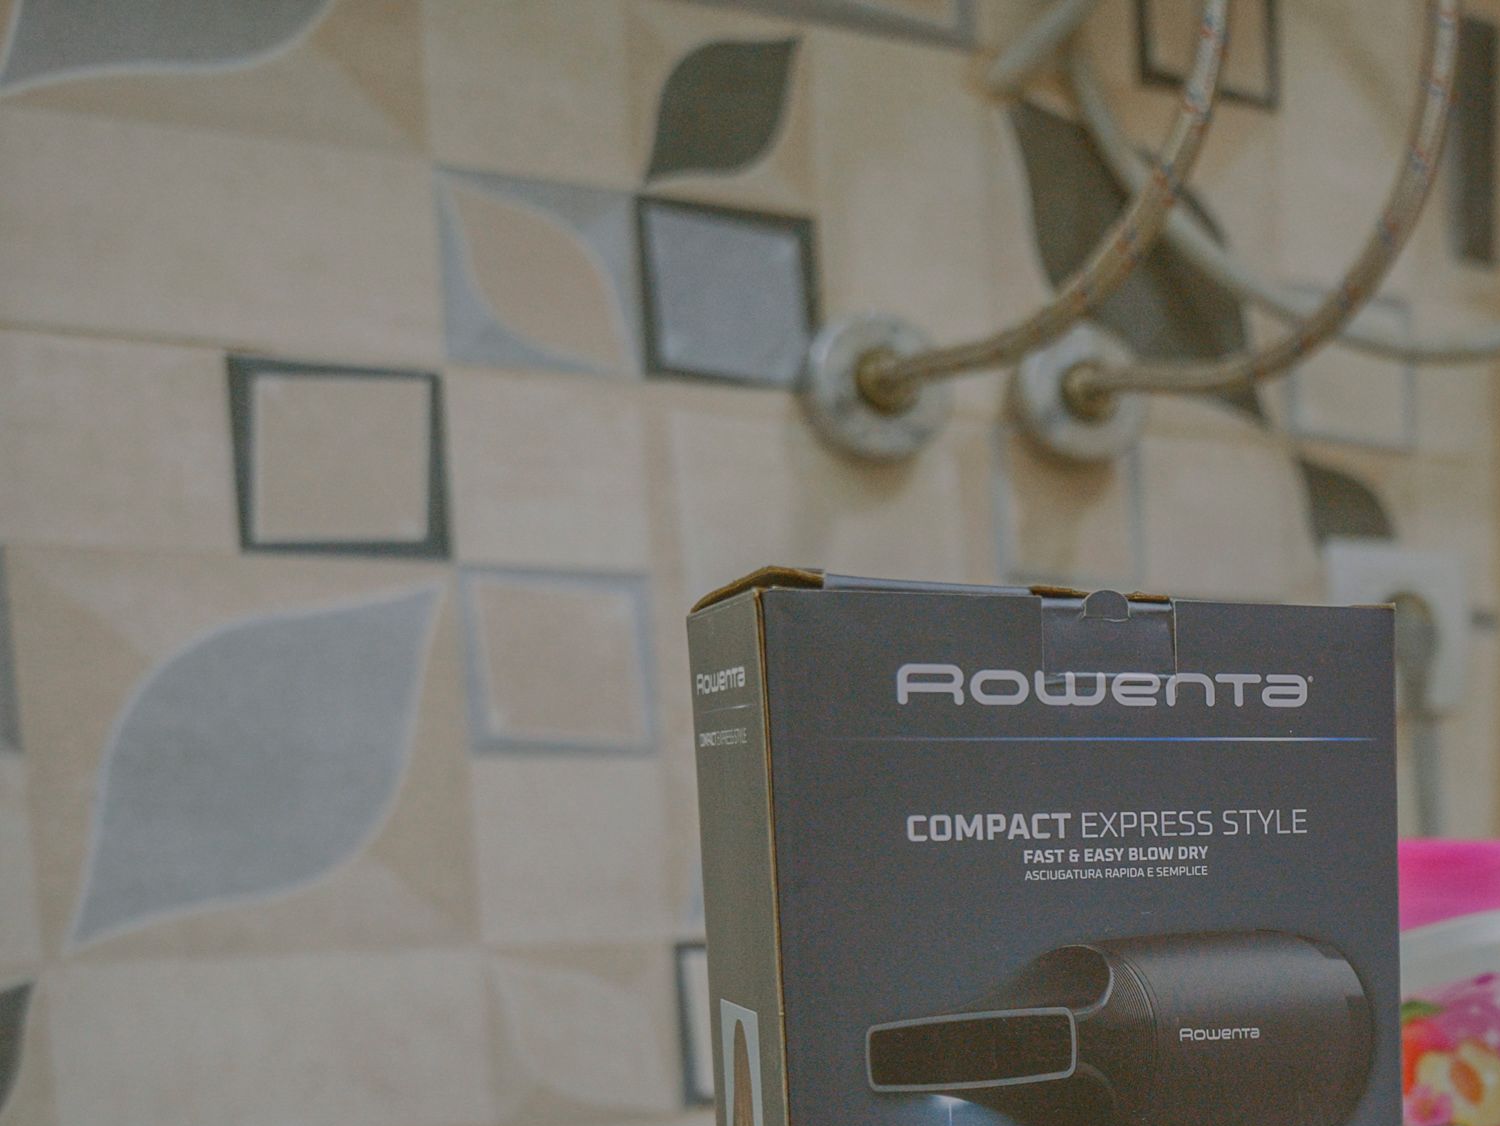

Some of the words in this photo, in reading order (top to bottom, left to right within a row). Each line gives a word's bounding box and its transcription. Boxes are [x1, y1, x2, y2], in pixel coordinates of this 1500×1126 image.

[696, 666, 745, 695] Rowenta
[897, 663, 1308, 708] Rowenta
[907, 812, 1071, 841] COMPACT
[1082, 810, 1213, 838] EXPRESS
[1222, 808, 1307, 835] STYLE
[1023, 849, 1065, 863] FAST
[1069, 849, 1080, 863] &
[1084, 848, 1124, 862] EASY
[1128, 846, 1174, 861] BLOW
[1178, 846, 1209, 860] DRY
[1024, 868, 1103, 881] ASCIUGATURA
[1105, 867, 1144, 878] RAPIDA
[1147, 867, 1154, 877] E
[1156, 865, 1208, 877] SEMPLICE
[1180, 1027, 1260, 1041] Rowenta
